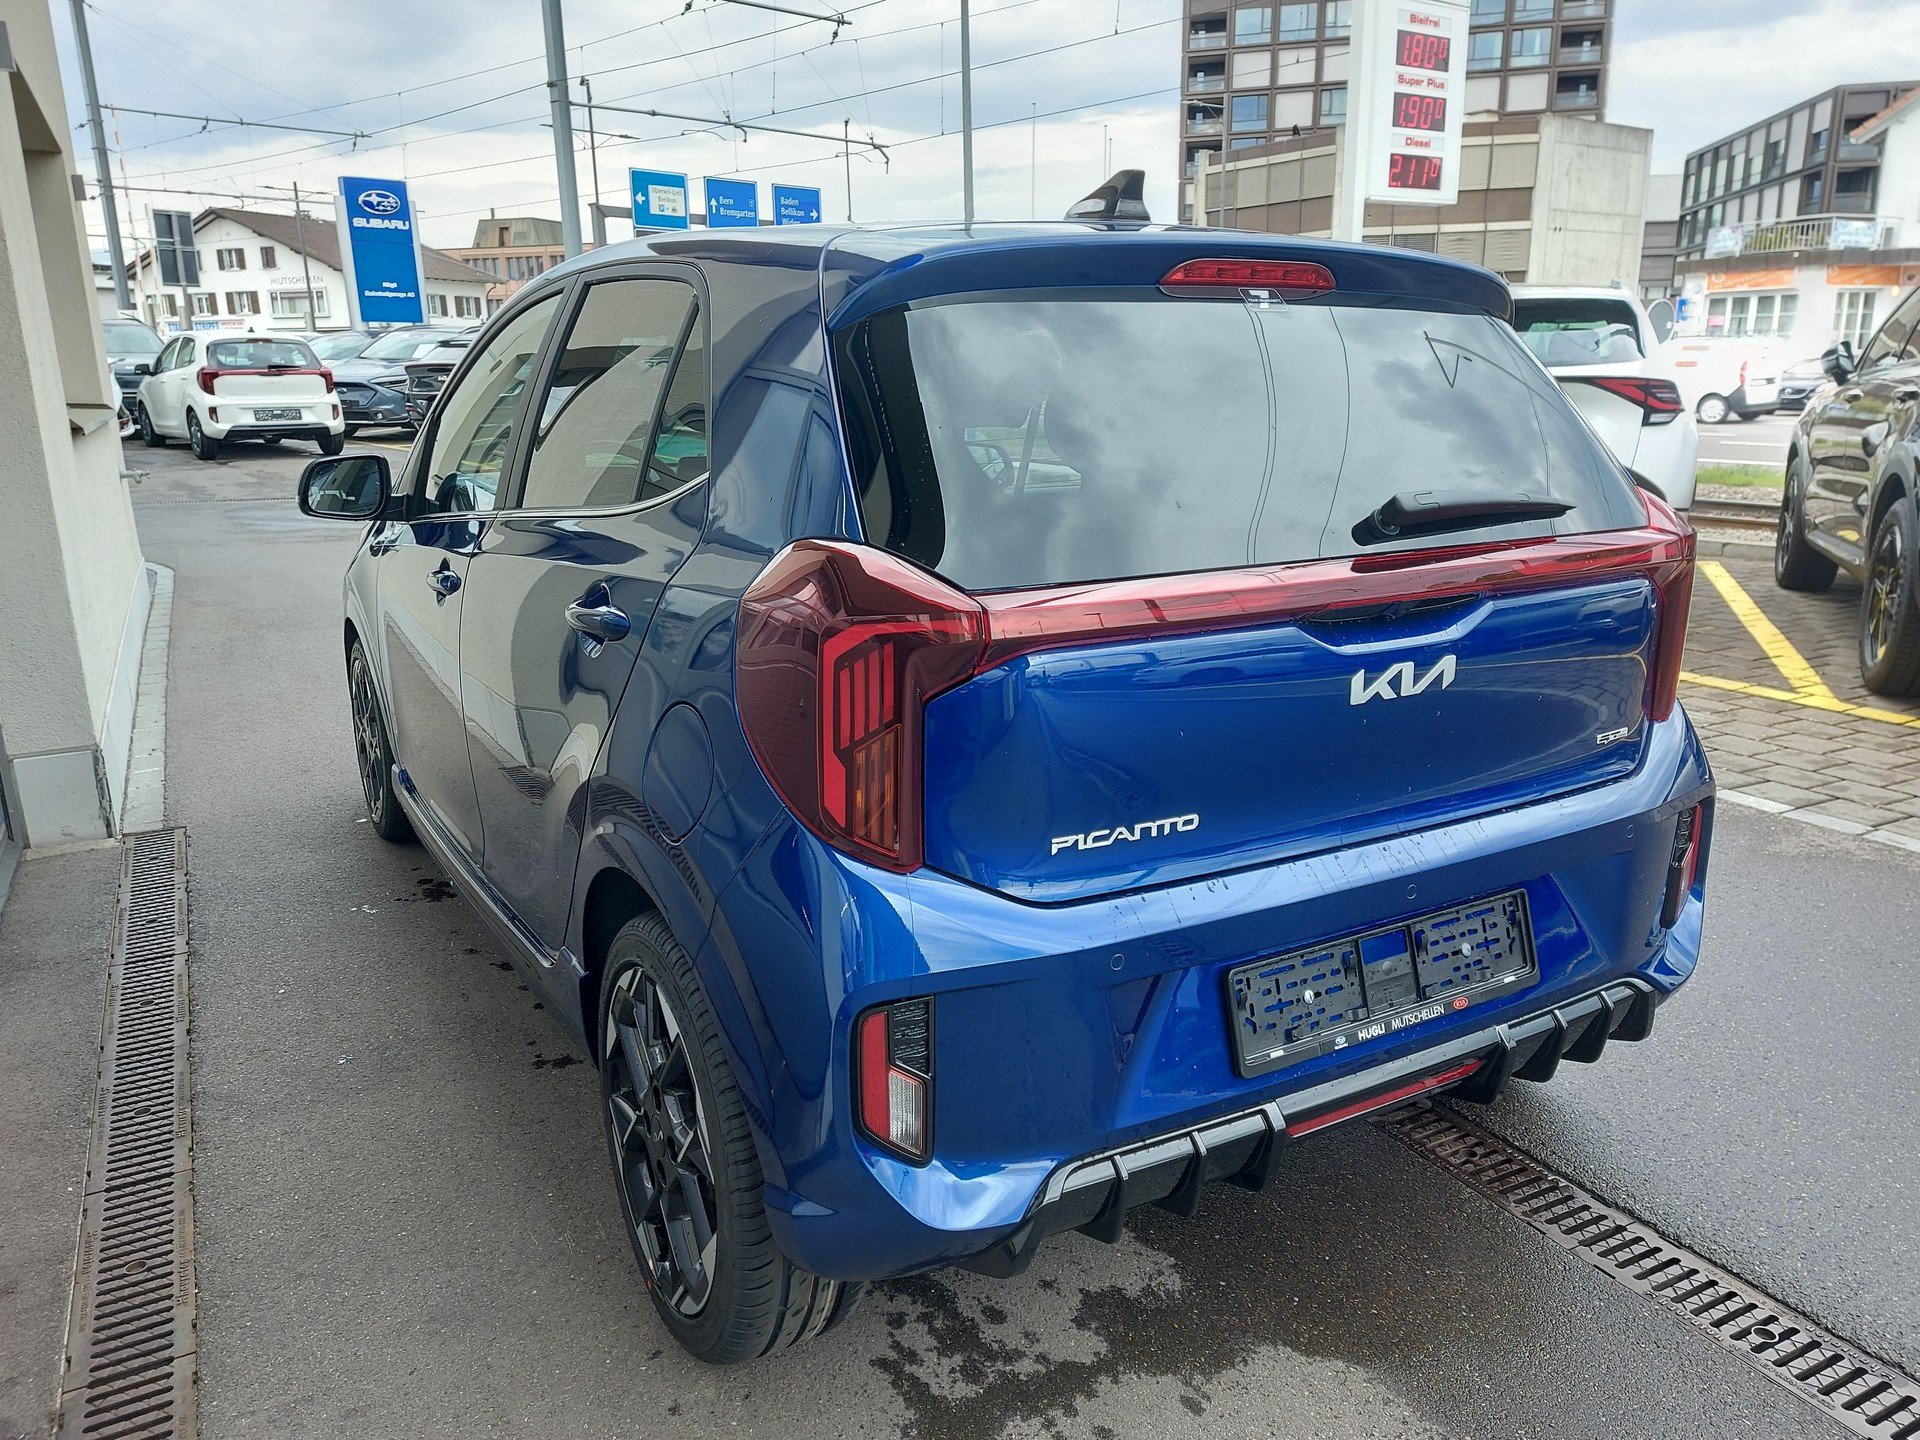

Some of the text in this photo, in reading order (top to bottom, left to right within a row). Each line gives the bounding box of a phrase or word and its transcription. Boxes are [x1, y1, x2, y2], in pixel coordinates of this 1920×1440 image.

[1410, 14, 1440, 28] Bleifrei
[1398, 74, 1445, 90] Super Plus
[1405, 137, 1431, 149] Diesel
[719, 196, 734, 205] Bern
[780, 196, 799, 206] Baden
[720, 207, 756, 218] Bremgarten
[781, 207, 805, 217] Bellikon
[352, 217, 410, 230] SUBARU
[1350, 655, 1457, 706] KIA
[1051, 813, 1200, 856] PICANTO
[1391, 1004, 1445, 1031] MUTSCHELLEN
